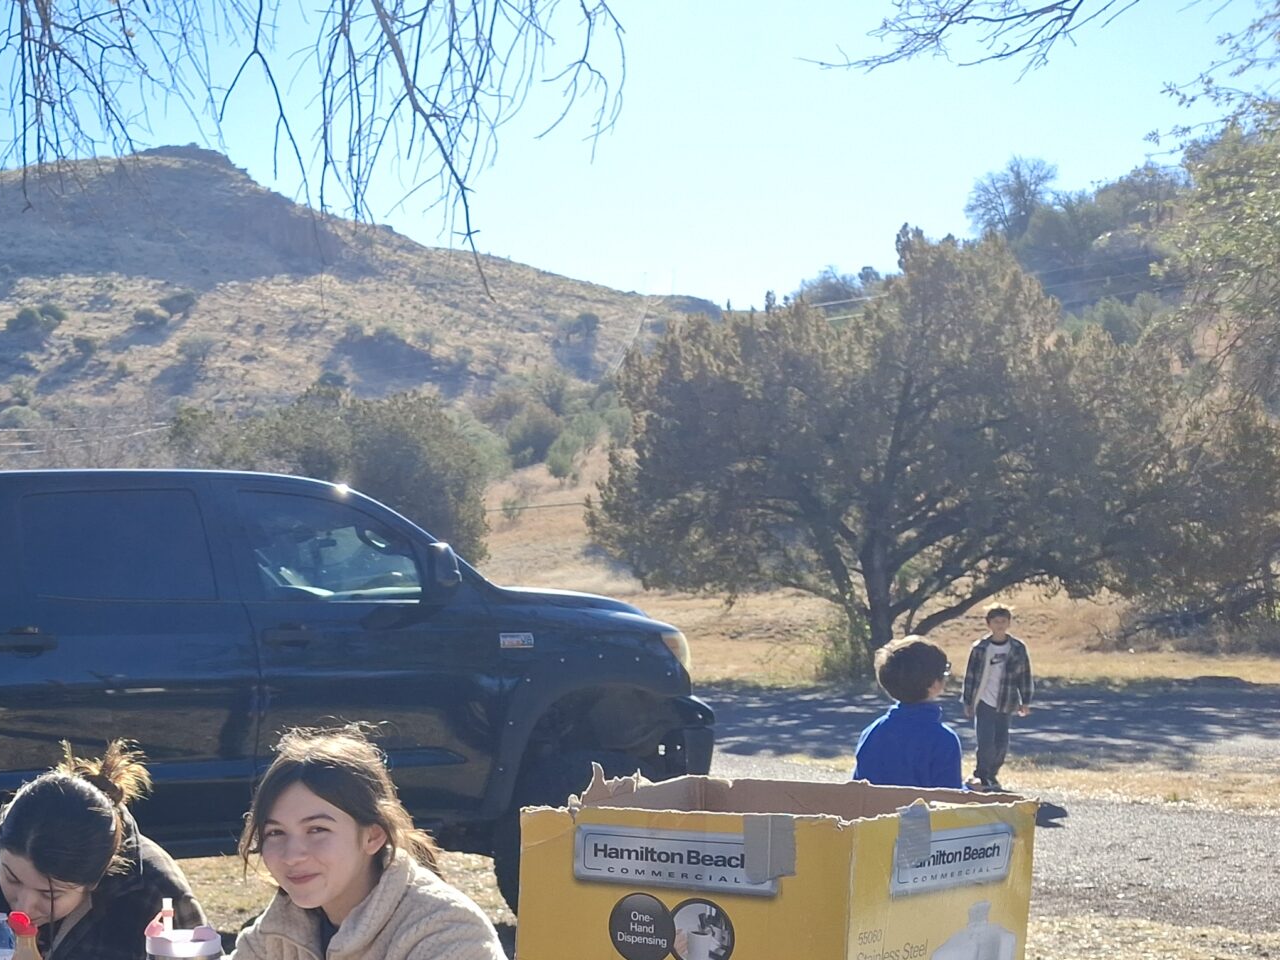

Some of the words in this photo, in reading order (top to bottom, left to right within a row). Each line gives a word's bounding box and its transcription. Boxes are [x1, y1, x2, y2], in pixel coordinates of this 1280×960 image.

[593, 843, 683, 864] Hamilton
[914, 850, 961, 868] milton
[963, 843, 1000, 862] Beach
[607, 866, 741, 884] COMMERCIAL
[912, 867, 990, 884] COMMERCIAL
[631, 911, 654, 922] One-
[630, 923, 654, 934] Hand
[617, 932, 667, 948] Dispensing
[902, 939, 929, 960] Steel
